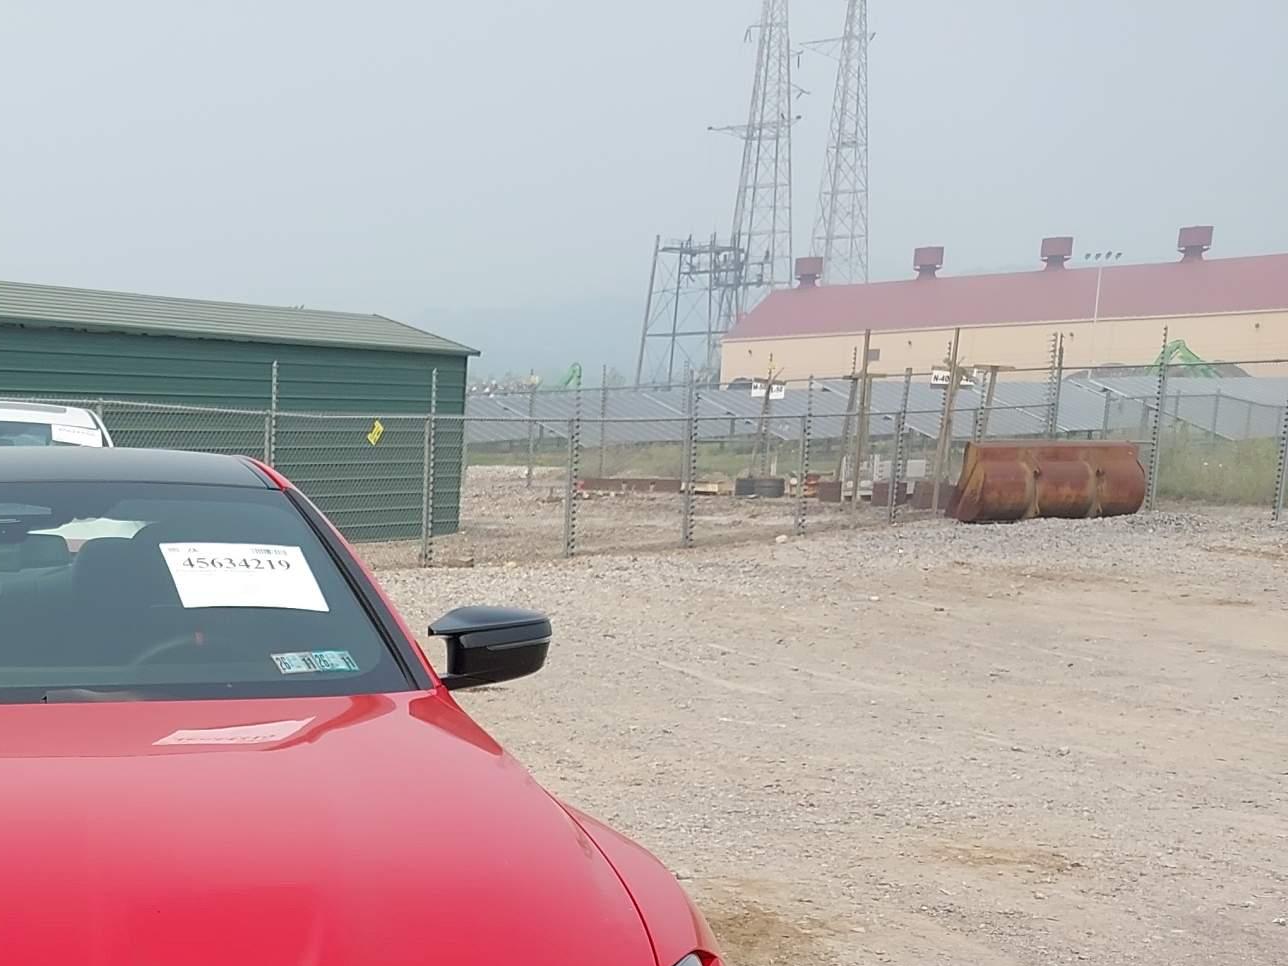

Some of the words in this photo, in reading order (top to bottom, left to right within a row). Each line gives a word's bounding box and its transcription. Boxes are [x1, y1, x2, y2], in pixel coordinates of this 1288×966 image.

[182, 556, 291, 571] 45634219
[275, 656, 292, 671] 26
[314, 653, 331, 668] 26
